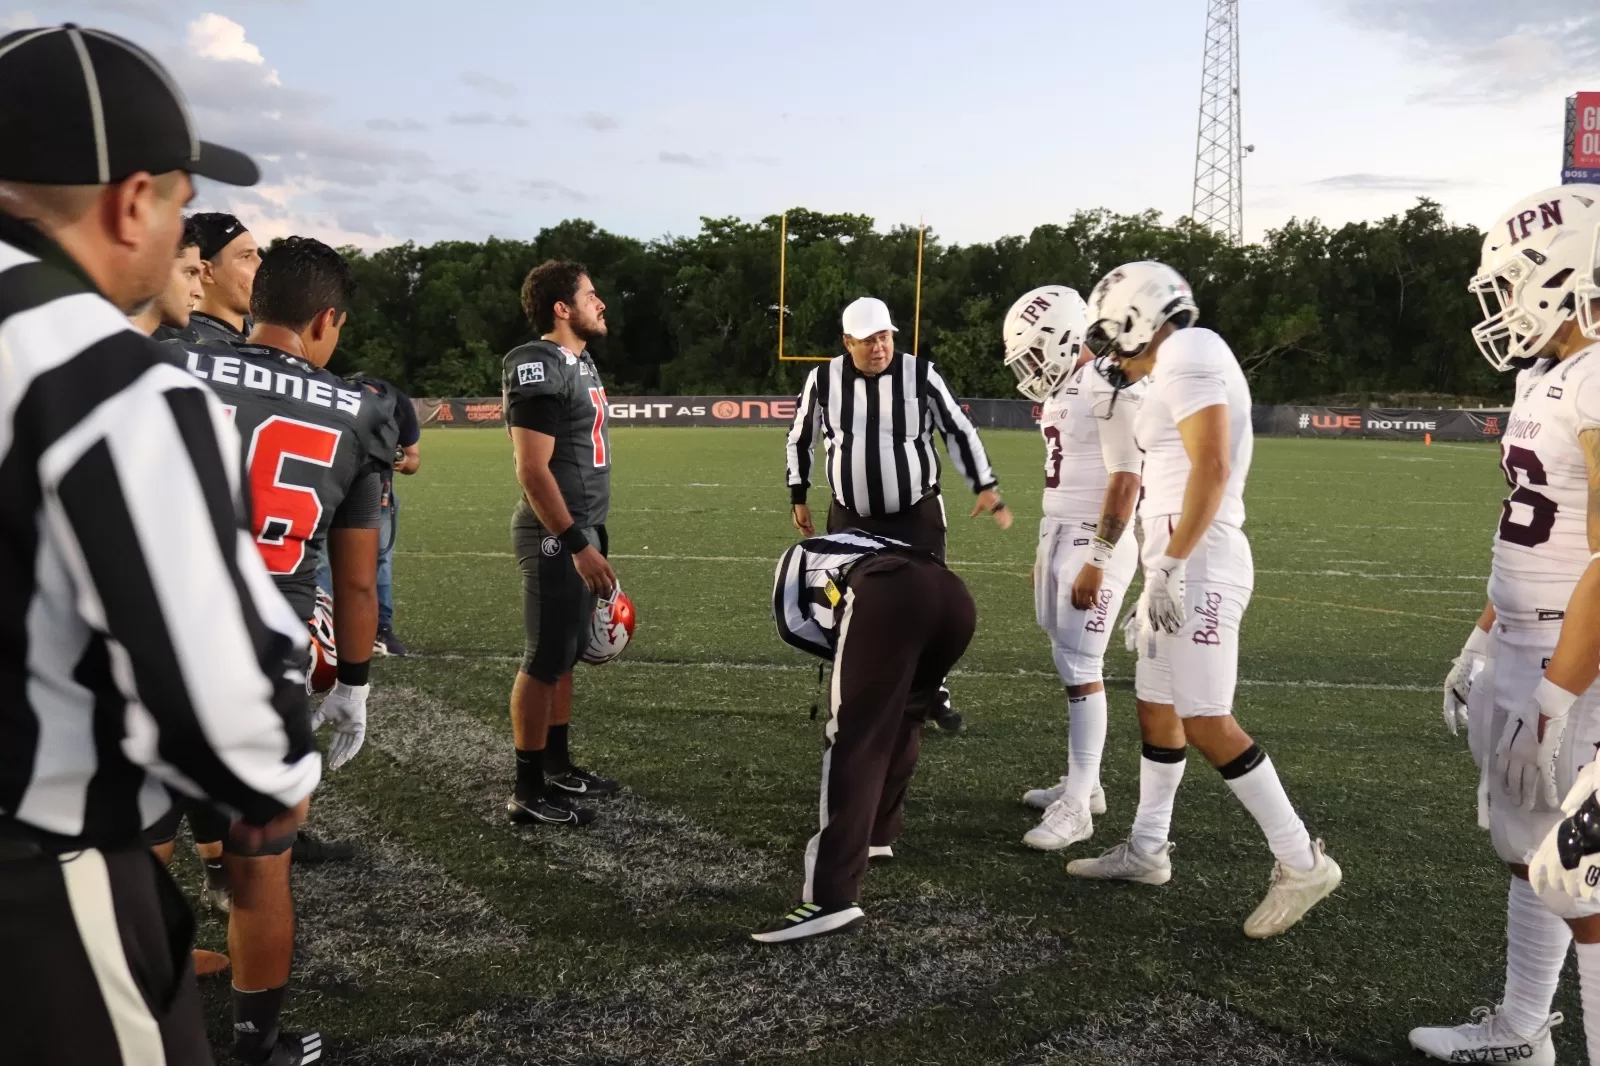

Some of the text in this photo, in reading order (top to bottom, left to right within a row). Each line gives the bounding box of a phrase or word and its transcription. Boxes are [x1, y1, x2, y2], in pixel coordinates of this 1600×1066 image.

[1564, 170, 1588, 178] BOSS
[1506, 199, 1564, 246] IPN
[1019, 295, 1052, 327] IPN
[186, 351, 362, 417] LEONES
[676, 406, 706, 416] AS
[711, 400, 797, 420] ONE
[222, 402, 343, 576] 6
[1192, 591, 1222, 646] Búhos
